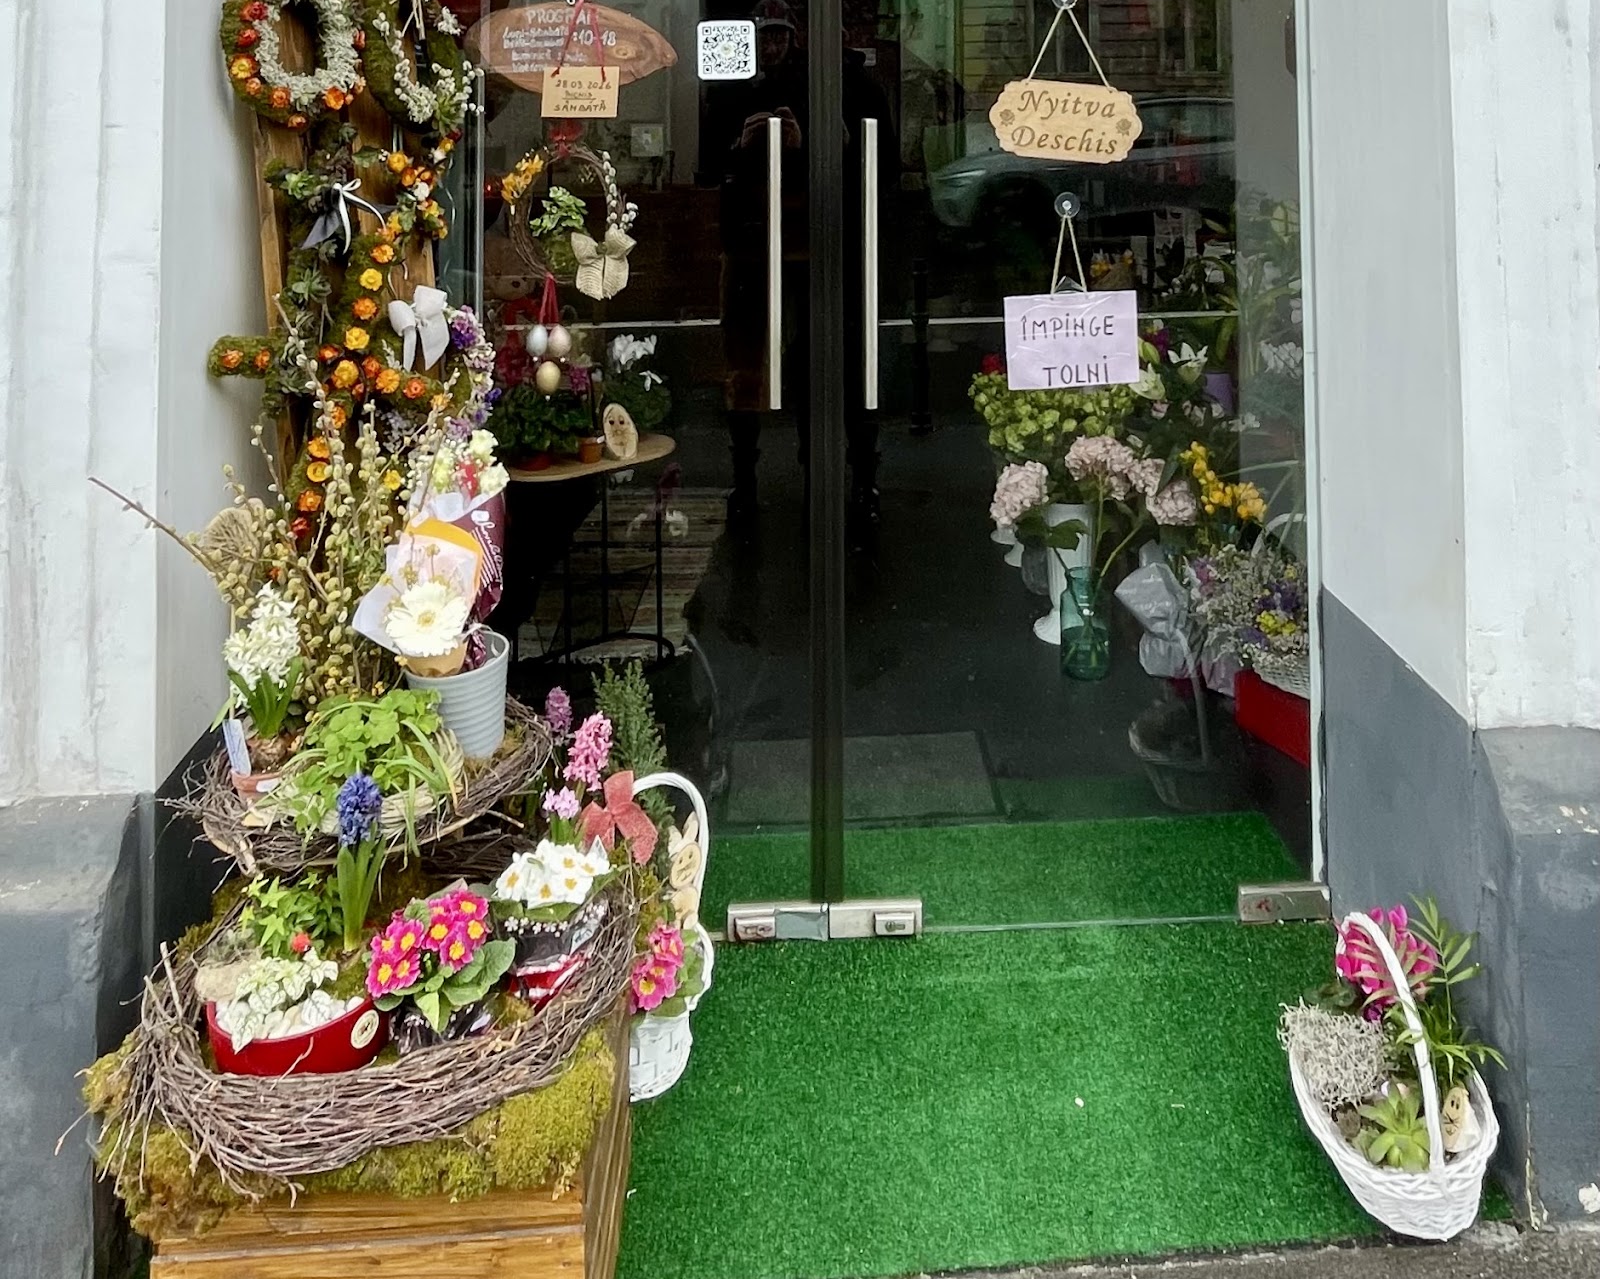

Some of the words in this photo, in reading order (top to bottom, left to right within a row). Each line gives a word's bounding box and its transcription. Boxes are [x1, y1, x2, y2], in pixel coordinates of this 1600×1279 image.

[1017, 90, 1115, 120] Nyitva
[1011, 125, 1118, 155] Deschis
[1042, 355, 1109, 387] TOLNI
